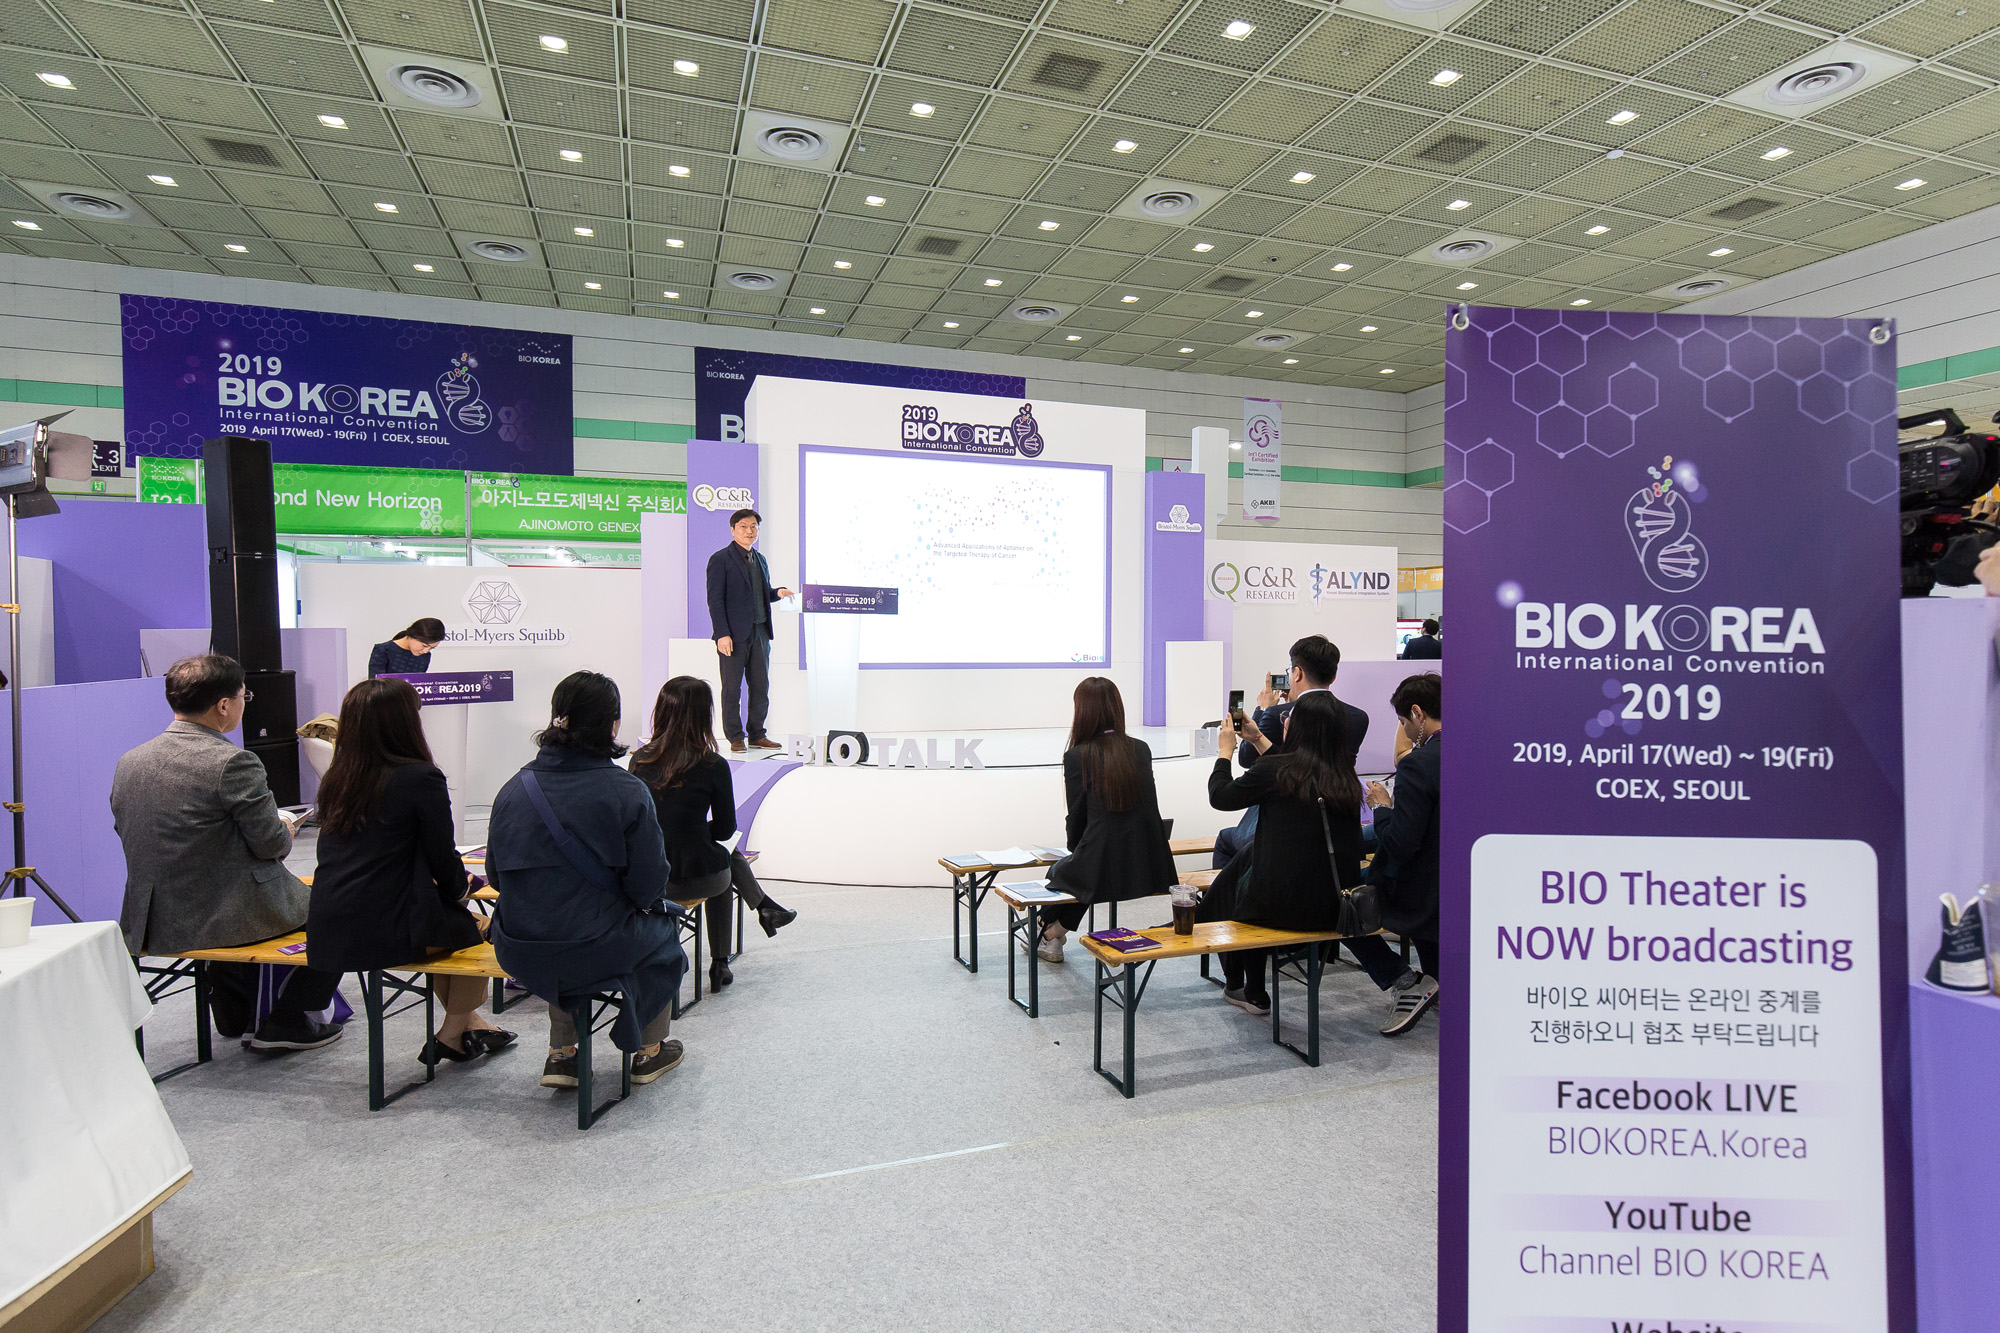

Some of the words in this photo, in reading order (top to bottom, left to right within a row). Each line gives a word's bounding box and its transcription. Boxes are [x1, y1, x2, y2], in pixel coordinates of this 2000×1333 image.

[218, 352, 282, 376] 2019
[518, 355, 532, 363] BIO
[532, 356, 561, 365] KOREA
[707, 370, 719, 378] BIO
[719, 372, 745, 380] KOREA
[218, 377, 293, 409] BIO
[299, 381, 439, 419] KOREA
[220, 407, 334, 425] International
[343, 415, 438, 431] Convention
[903, 406, 937, 420] 2019
[219, 423, 247, 434] 2019
[251, 425, 278, 437] April
[280, 427, 324, 438] 17(Wed)
[333, 430, 367, 442] 19(Fri)
[382, 433, 414, 445] COEX,
[416, 435, 450, 446] SEOUL
[903, 421, 941, 441] BIO
[943, 424, 1015, 447] KOREA
[108, 449, 120, 464] 3
[904, 439, 962, 451] International
[965, 443, 1015, 454] Convention
[99, 464, 119, 472] EXIT
[485, 478, 511, 486] KOREA
[316, 489, 361, 508] New
[367, 491, 442, 510] Horizon
[481, 488, 621, 512] 아지노모도제넥신
[716, 488, 752, 502] C&R
[717, 501, 751, 509] RESEARCH
[518, 518, 594, 532] AJINOMOTO
[933, 541, 961, 549] Advanced
[962, 542, 996, 551] Applications
[996, 543, 1002, 551] of
[943, 550, 968, 558] Targeted
[968, 551, 990, 559] Therapy
[1244, 565, 1298, 589] C&R
[822, 596, 835, 604] BIO
[836, 596, 876, 605] KREA2019
[1246, 589, 1295, 600] RESEARCH
[518, 628, 565, 644] Squibb
[1515, 601, 1617, 650] BIO
[1625, 603, 1826, 654] KOREA
[1516, 652, 1674, 672] International
[1685, 655, 1826, 675] Convention
[1620, 682, 1722, 721] 2019
[787, 733, 862, 768] BIO
[869, 737, 985, 770] TALK
[1512, 742, 1573, 767] 2019,
[1579, 744, 1635, 768] April
[1640, 744, 1732, 769] 17(Wed)
[1761, 745, 1835, 770] 19(Fri)
[1595, 778, 1667, 802] COEX,
[1672, 779, 1751, 801] SEOUL
[1541, 870, 1608, 905] BIO
[1619, 870, 1767, 908] Theater
[1778, 873, 1808, 909] is
[1496, 925, 1595, 961] NOW
[1607, 925, 1855, 972] broadcasting
[1526, 985, 1590, 1010] 바이오
[1596, 986, 1682, 1012] 씨어터는
[1687, 987, 1751, 1013] 온라인
[1757, 988, 1823, 1015] 중계를
[1528, 1019, 1635, 1045] 진행하오니
[1642, 1020, 1685, 1046] 협조
[1690, 1021, 1820, 1048] 부탁드립니다
[1556, 1080, 1713, 1112] Facebook
[1725, 1083, 1798, 1113] LIVE
[1549, 1125, 1808, 1159] BIOKOREA.Korea
[1603, 1200, 1752, 1232] YouTube
[1519, 1244, 1641, 1276] Channel
[1654, 1247, 1708, 1278] BIO
[1719, 1249, 1830, 1281] KOREA
